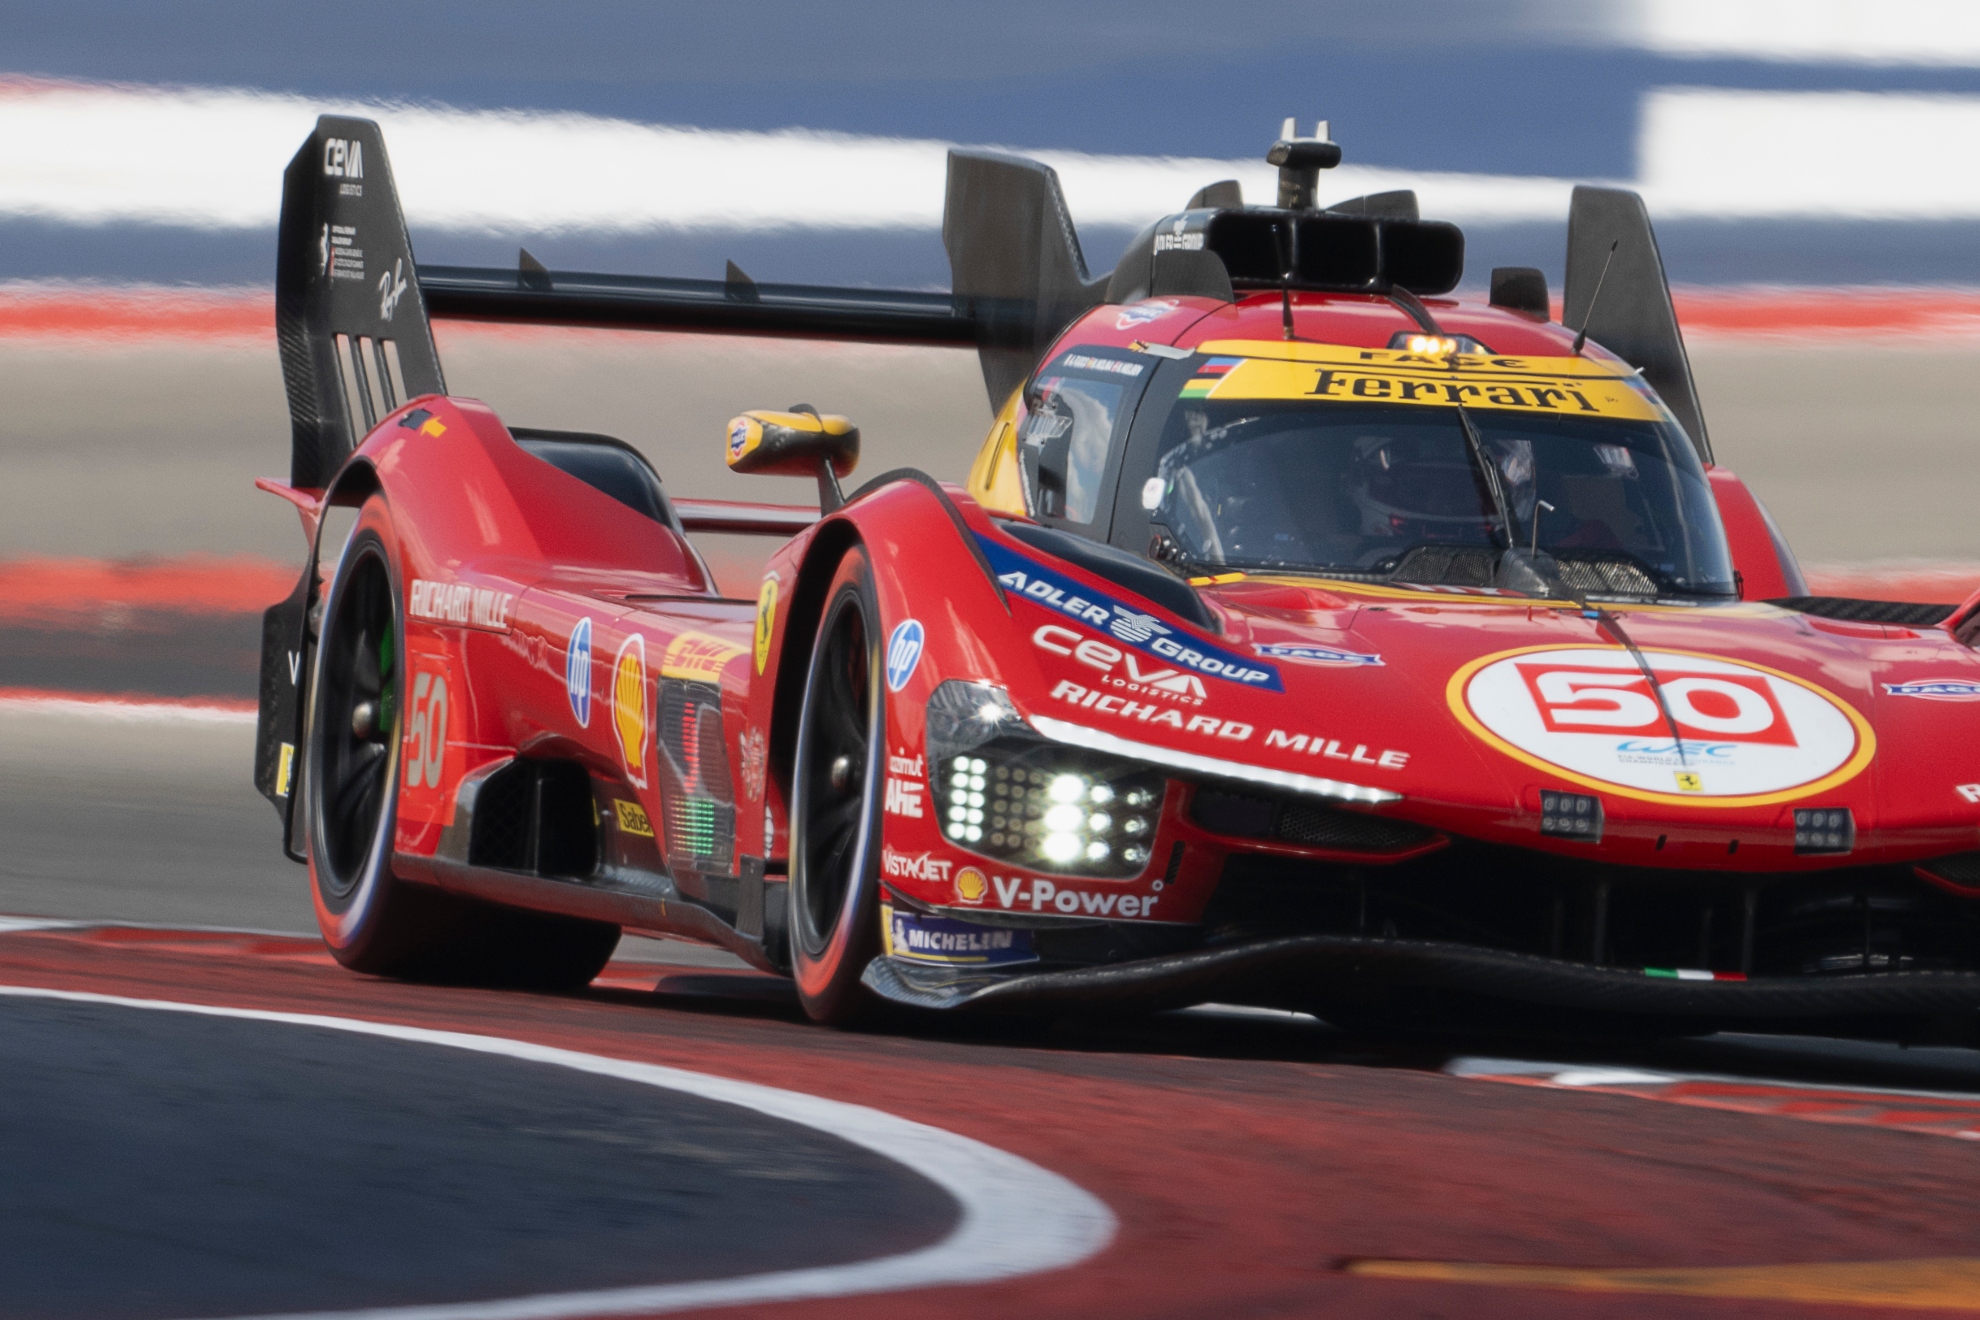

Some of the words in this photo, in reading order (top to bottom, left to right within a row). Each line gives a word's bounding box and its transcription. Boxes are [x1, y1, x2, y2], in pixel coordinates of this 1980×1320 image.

[1304, 365, 1601, 412] Ferrari
[409, 579, 471, 623] RICHARD
[471, 587, 513, 629] MILLE
[1000, 571, 1111, 625] ADLER
[1151, 636, 1270, 683] GROUP
[570, 619, 590, 726] hp
[888, 620, 920, 690] hp
[1101, 674, 1203, 706] LOGISTICS
[1535, 670, 1775, 734] 50
[407, 672, 448, 789] 50
[1050, 679, 1254, 742] RICHARD
[1265, 729, 1411, 769] MILLE
[1616, 740, 1738, 758] WEC
[993, 877, 1158, 917] V-Power
[909, 930, 1014, 951] MICHELIN
